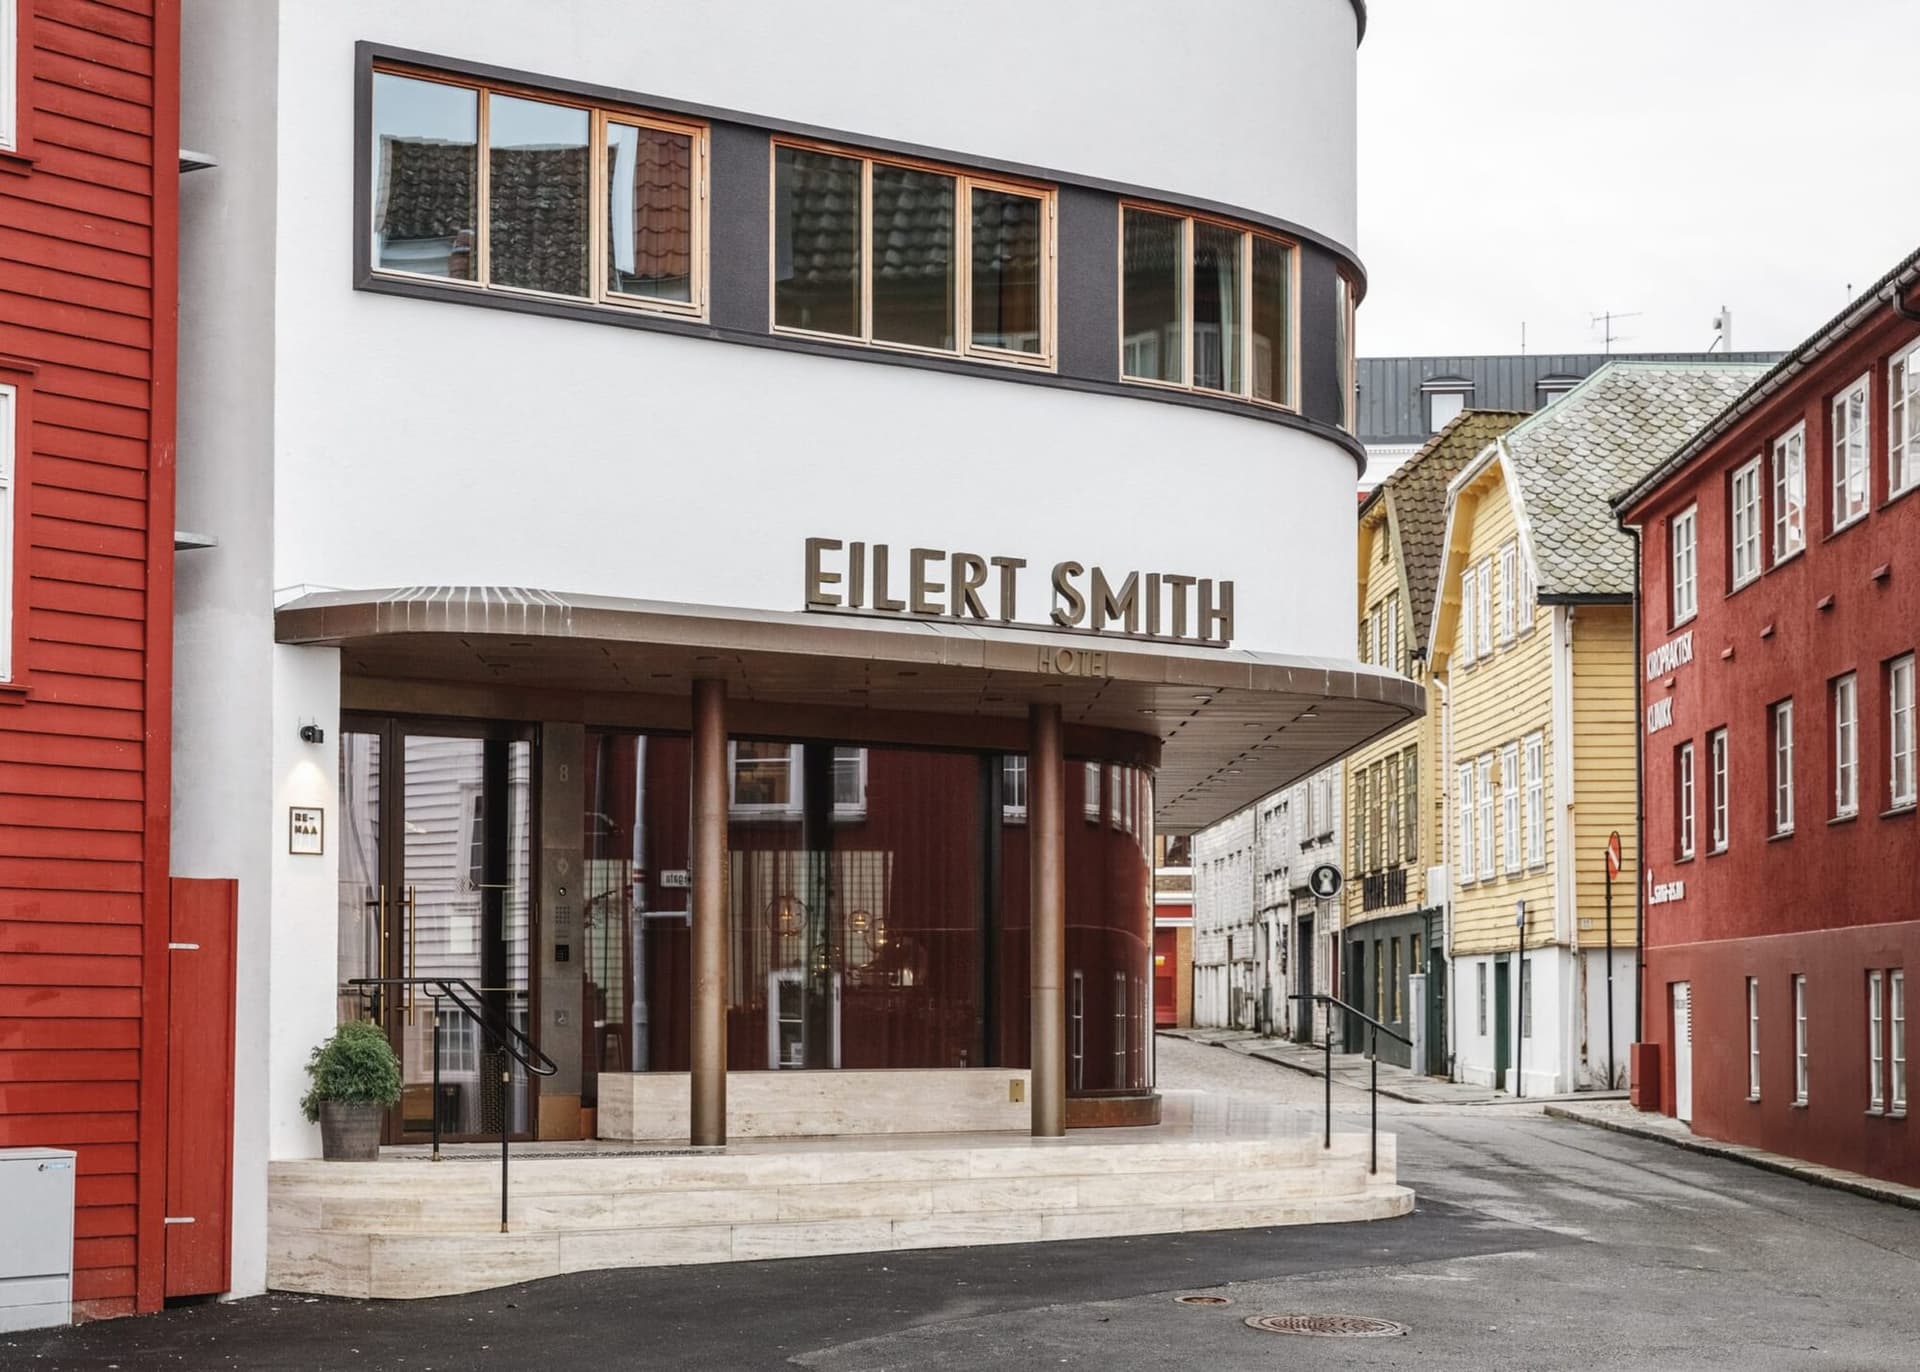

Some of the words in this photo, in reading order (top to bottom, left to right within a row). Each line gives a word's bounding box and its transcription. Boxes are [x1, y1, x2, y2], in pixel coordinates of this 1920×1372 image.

[805, 537, 1027, 622] EILERT
[1050, 560, 1235, 641] SMITH
[1037, 647, 1114, 679] HOTEL
[560, 764, 569, 781] 8
